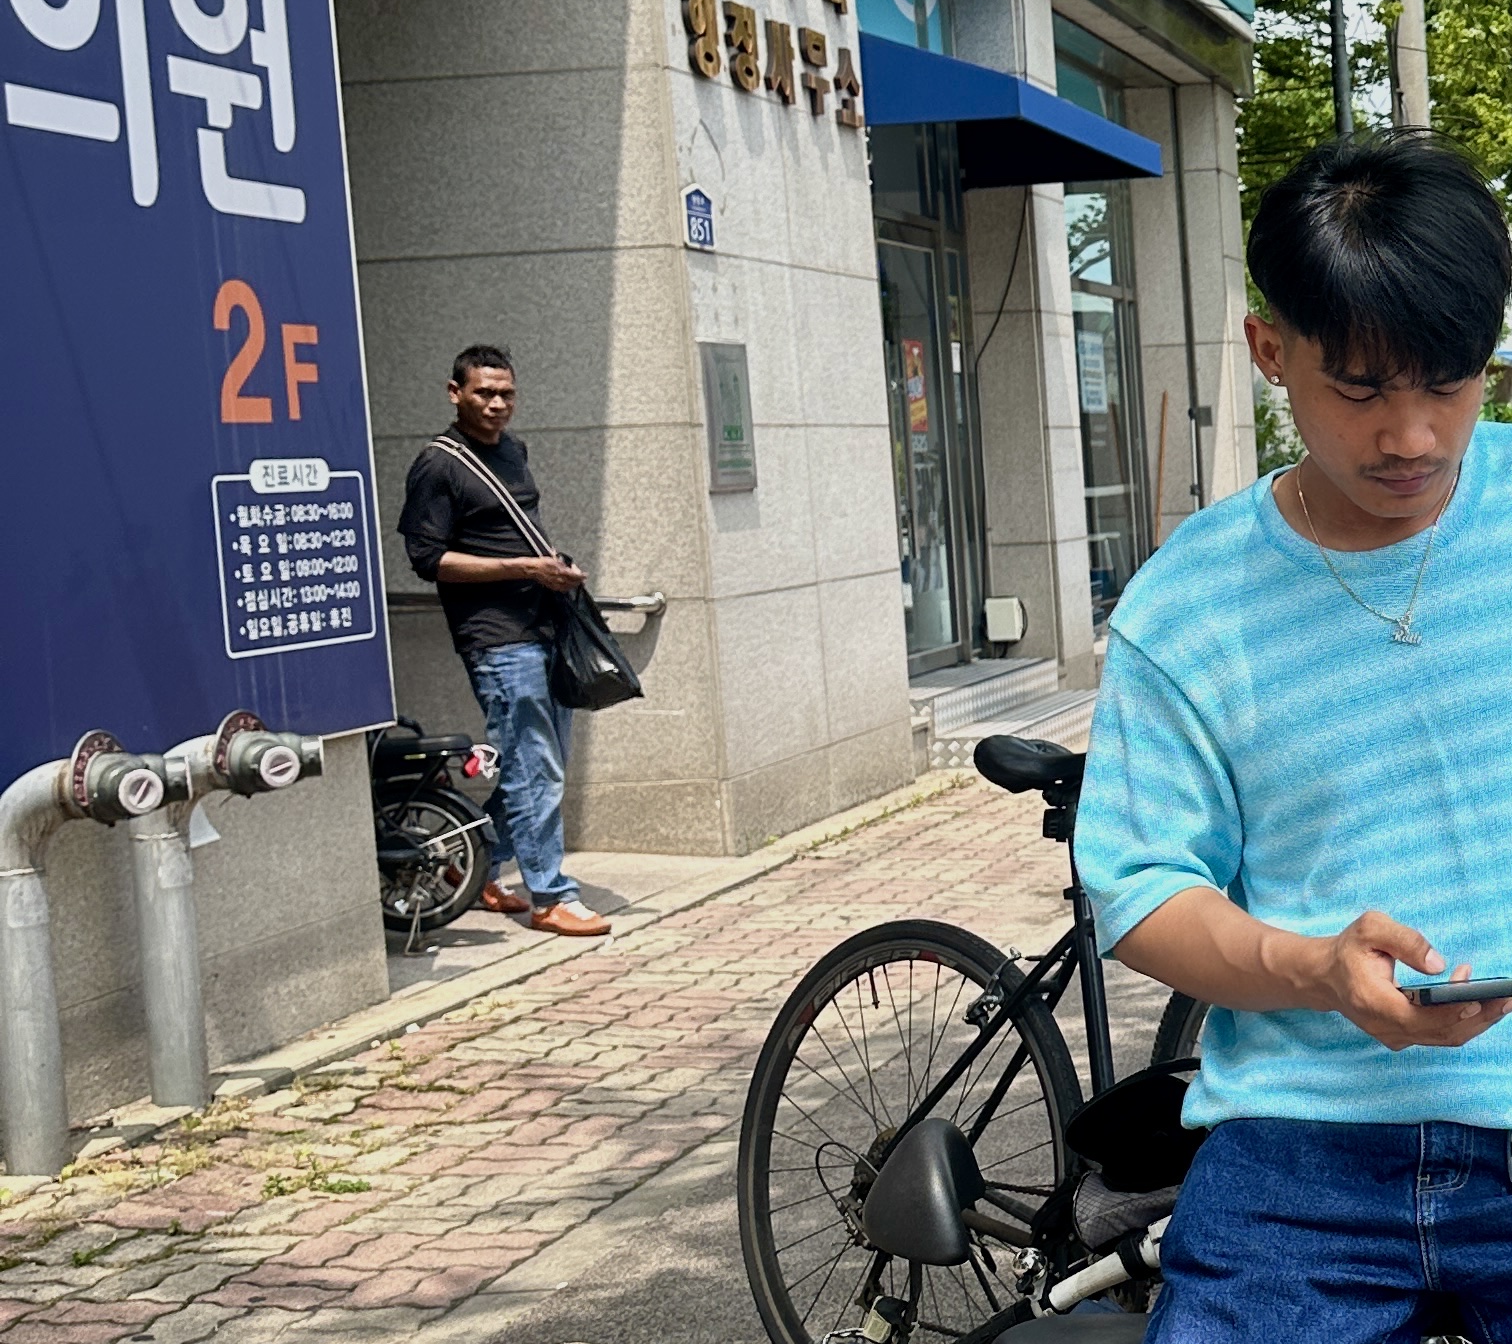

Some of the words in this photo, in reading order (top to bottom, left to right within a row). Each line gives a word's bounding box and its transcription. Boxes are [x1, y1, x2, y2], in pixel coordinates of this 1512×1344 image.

[690, 216, 711, 242] 851
[212, 278, 319, 424] 2F
[262, 464, 318, 488] 진료시간
